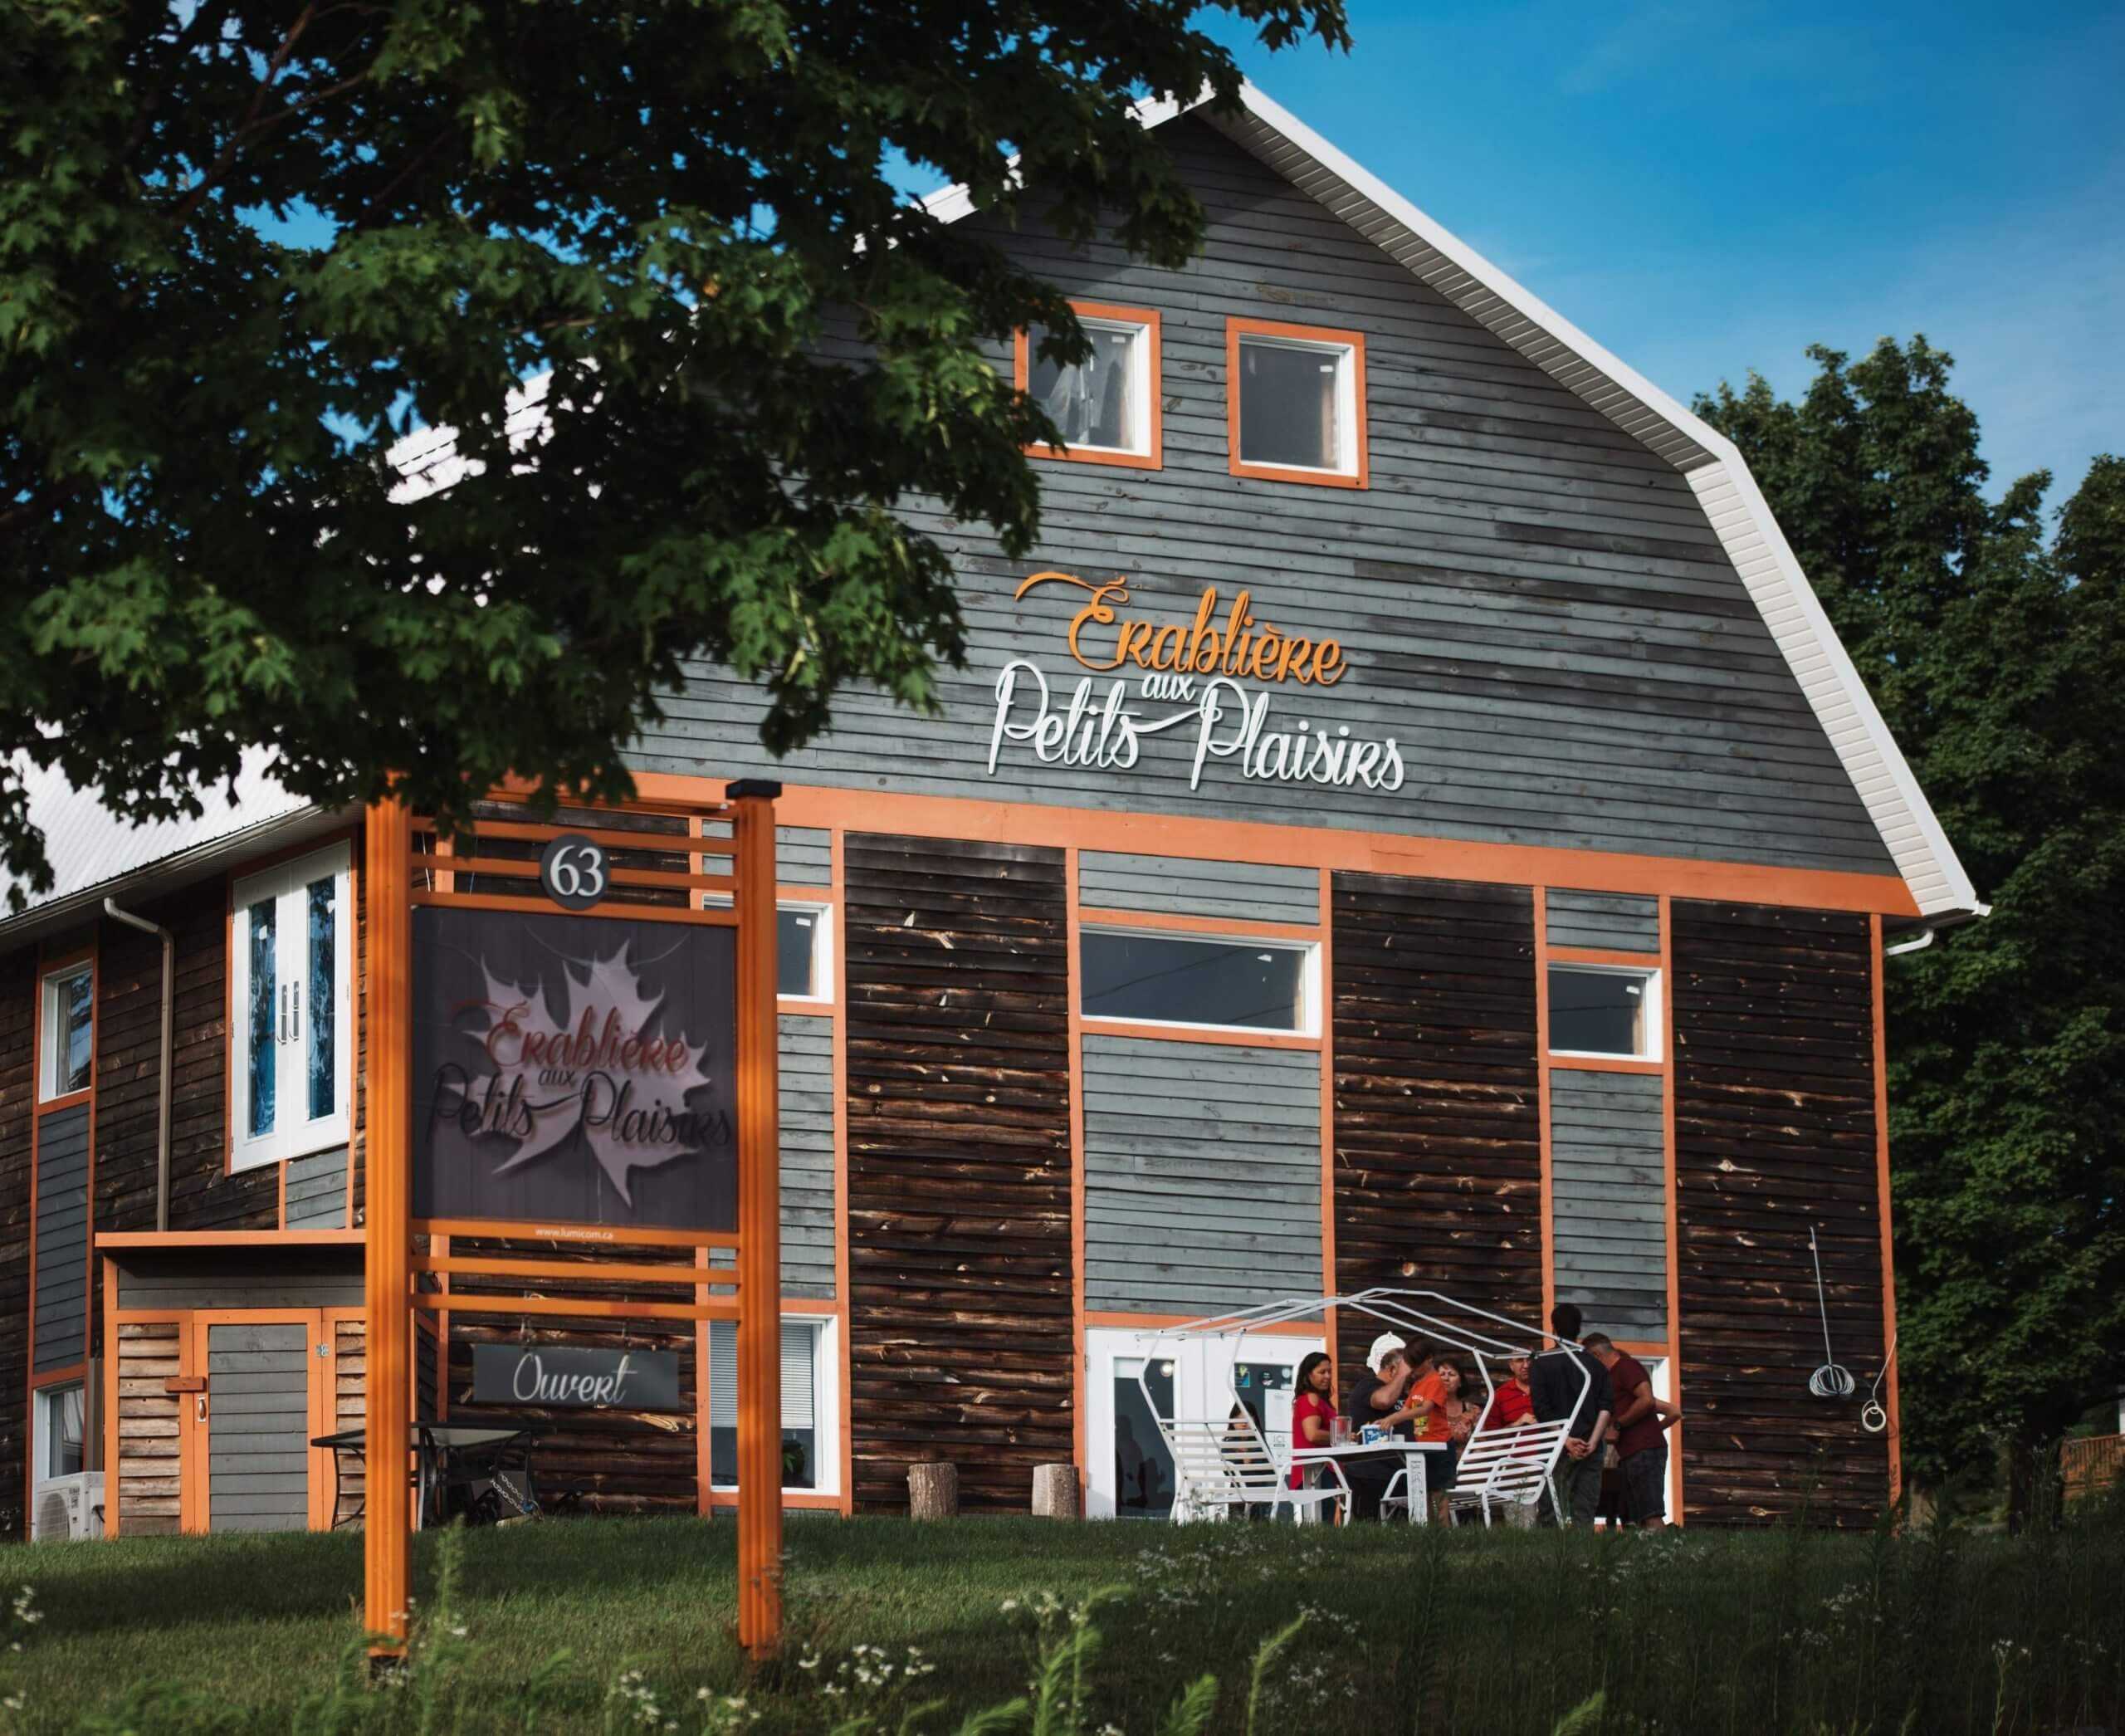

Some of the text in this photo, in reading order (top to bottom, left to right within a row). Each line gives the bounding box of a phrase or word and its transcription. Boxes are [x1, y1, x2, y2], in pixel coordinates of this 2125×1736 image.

[1014, 571, 1346, 686] Érablière
[1141, 673, 1198, 702] aux
[988, 660, 1404, 791] Petits Plaisirs
[549, 844, 604, 897] 63
[538, 1068, 576, 1087] aux
[425, 1062, 731, 1151] Petits Plaisirs
[512, 1352, 638, 1404] Ouvert
